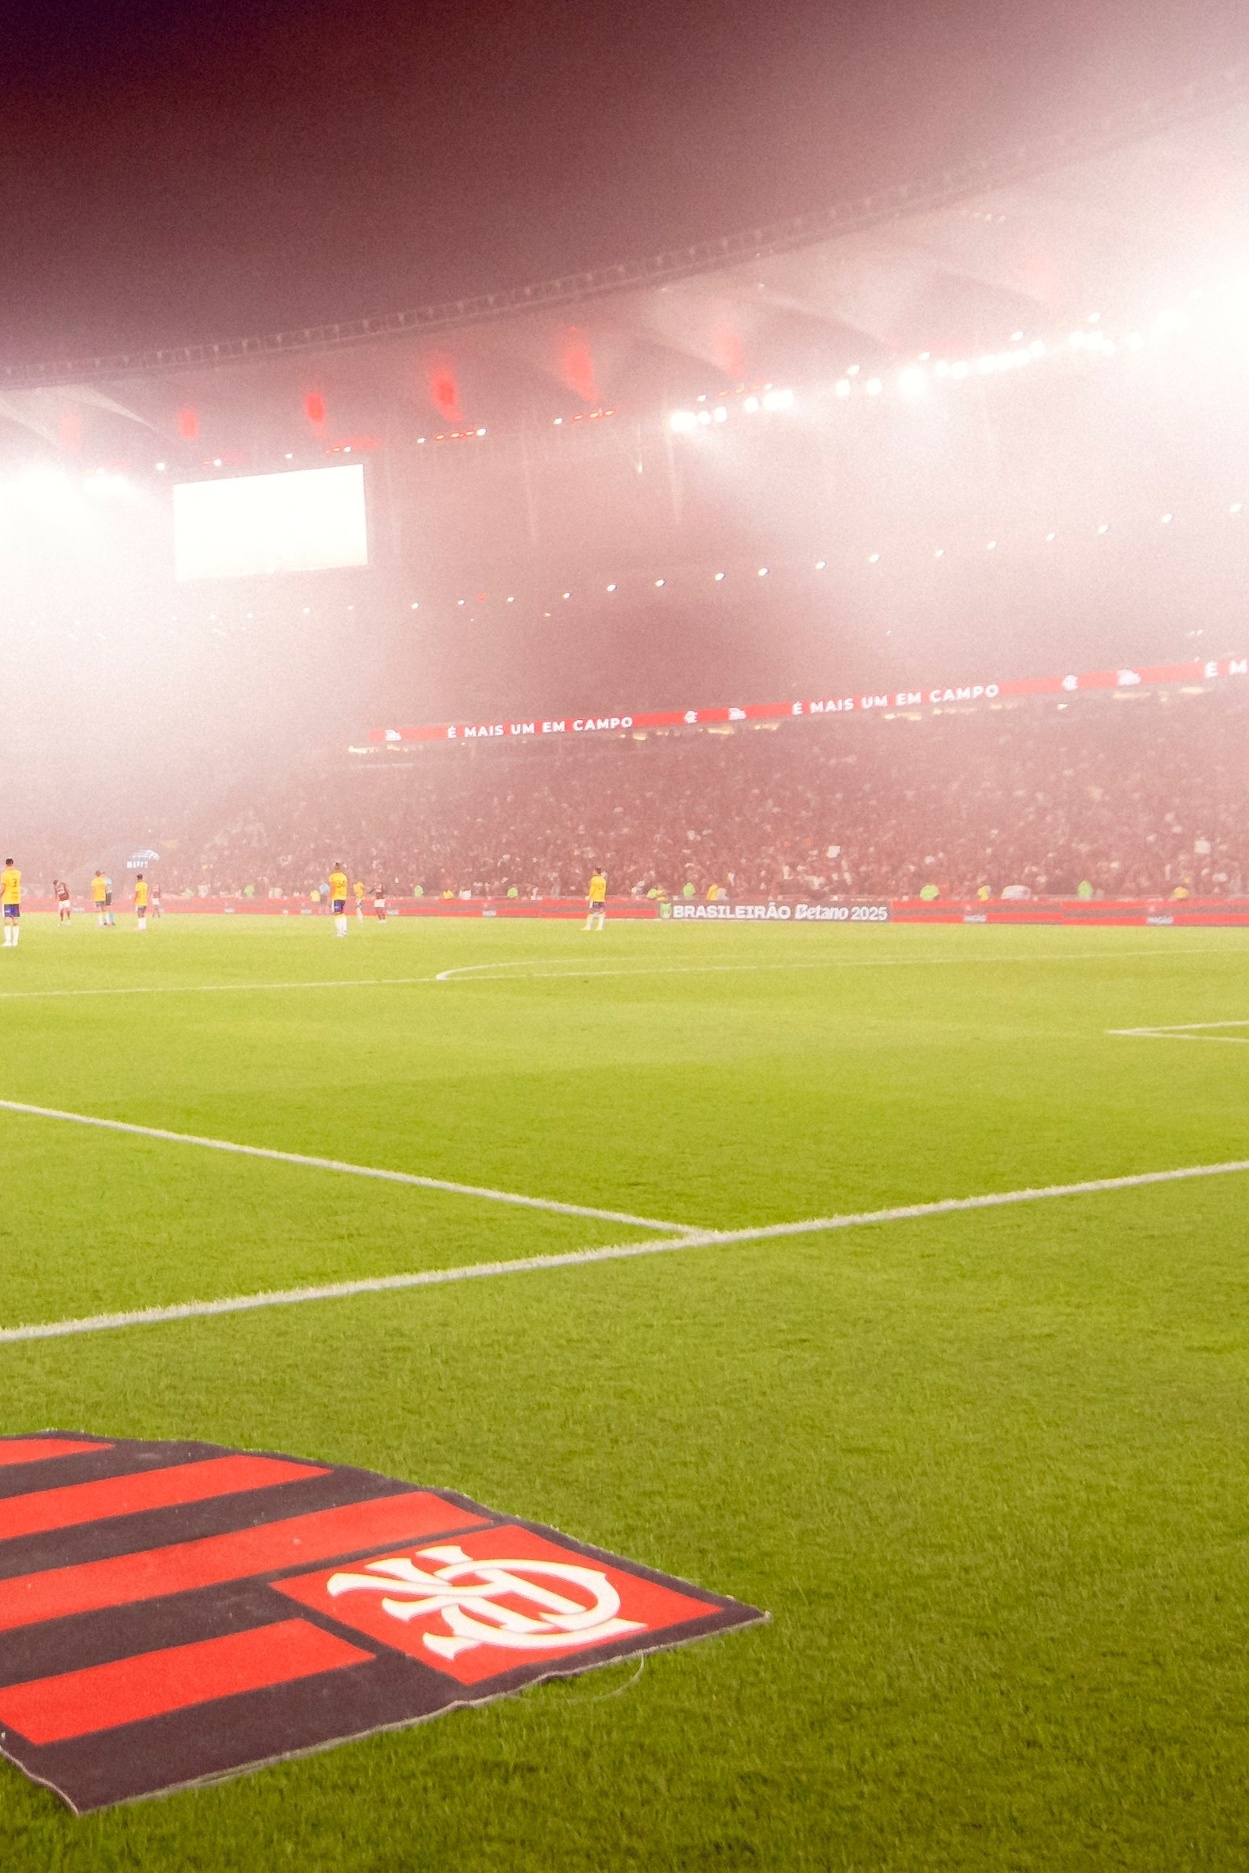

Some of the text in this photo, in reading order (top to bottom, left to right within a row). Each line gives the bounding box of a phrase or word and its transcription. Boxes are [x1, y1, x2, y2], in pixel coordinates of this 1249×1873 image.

[1204, 659, 1219, 678] É
[791, 684, 999, 715] É MAIS UM EM CAMPO
[447, 716, 633, 739] É MAIS UM EM CAMPO
[672, 902, 888, 921] BRASILEIRÃO Betano 2025
